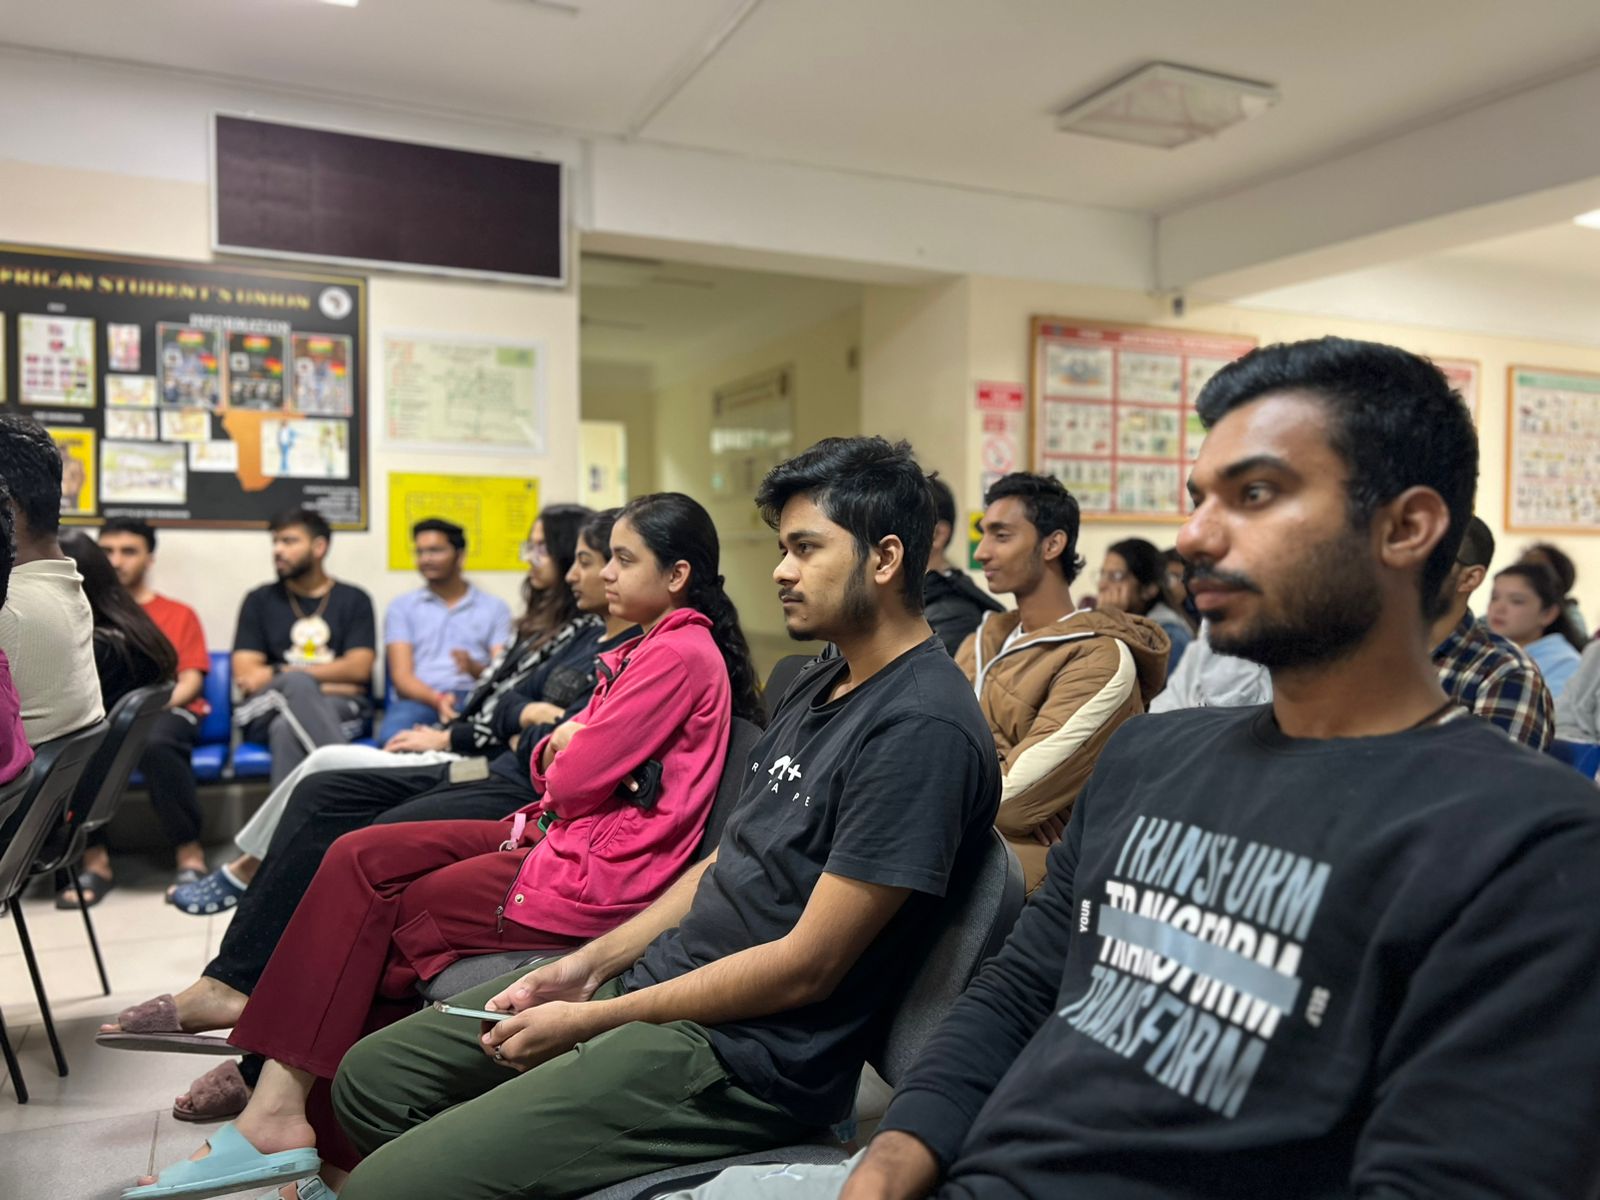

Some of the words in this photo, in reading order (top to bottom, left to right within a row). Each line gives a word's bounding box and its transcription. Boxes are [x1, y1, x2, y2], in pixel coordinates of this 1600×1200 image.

[1079, 898, 1092, 933] YOUR
[1114, 815, 1331, 941] TRANSFORM
[1058, 964, 1267, 1120] TRANSFORM
